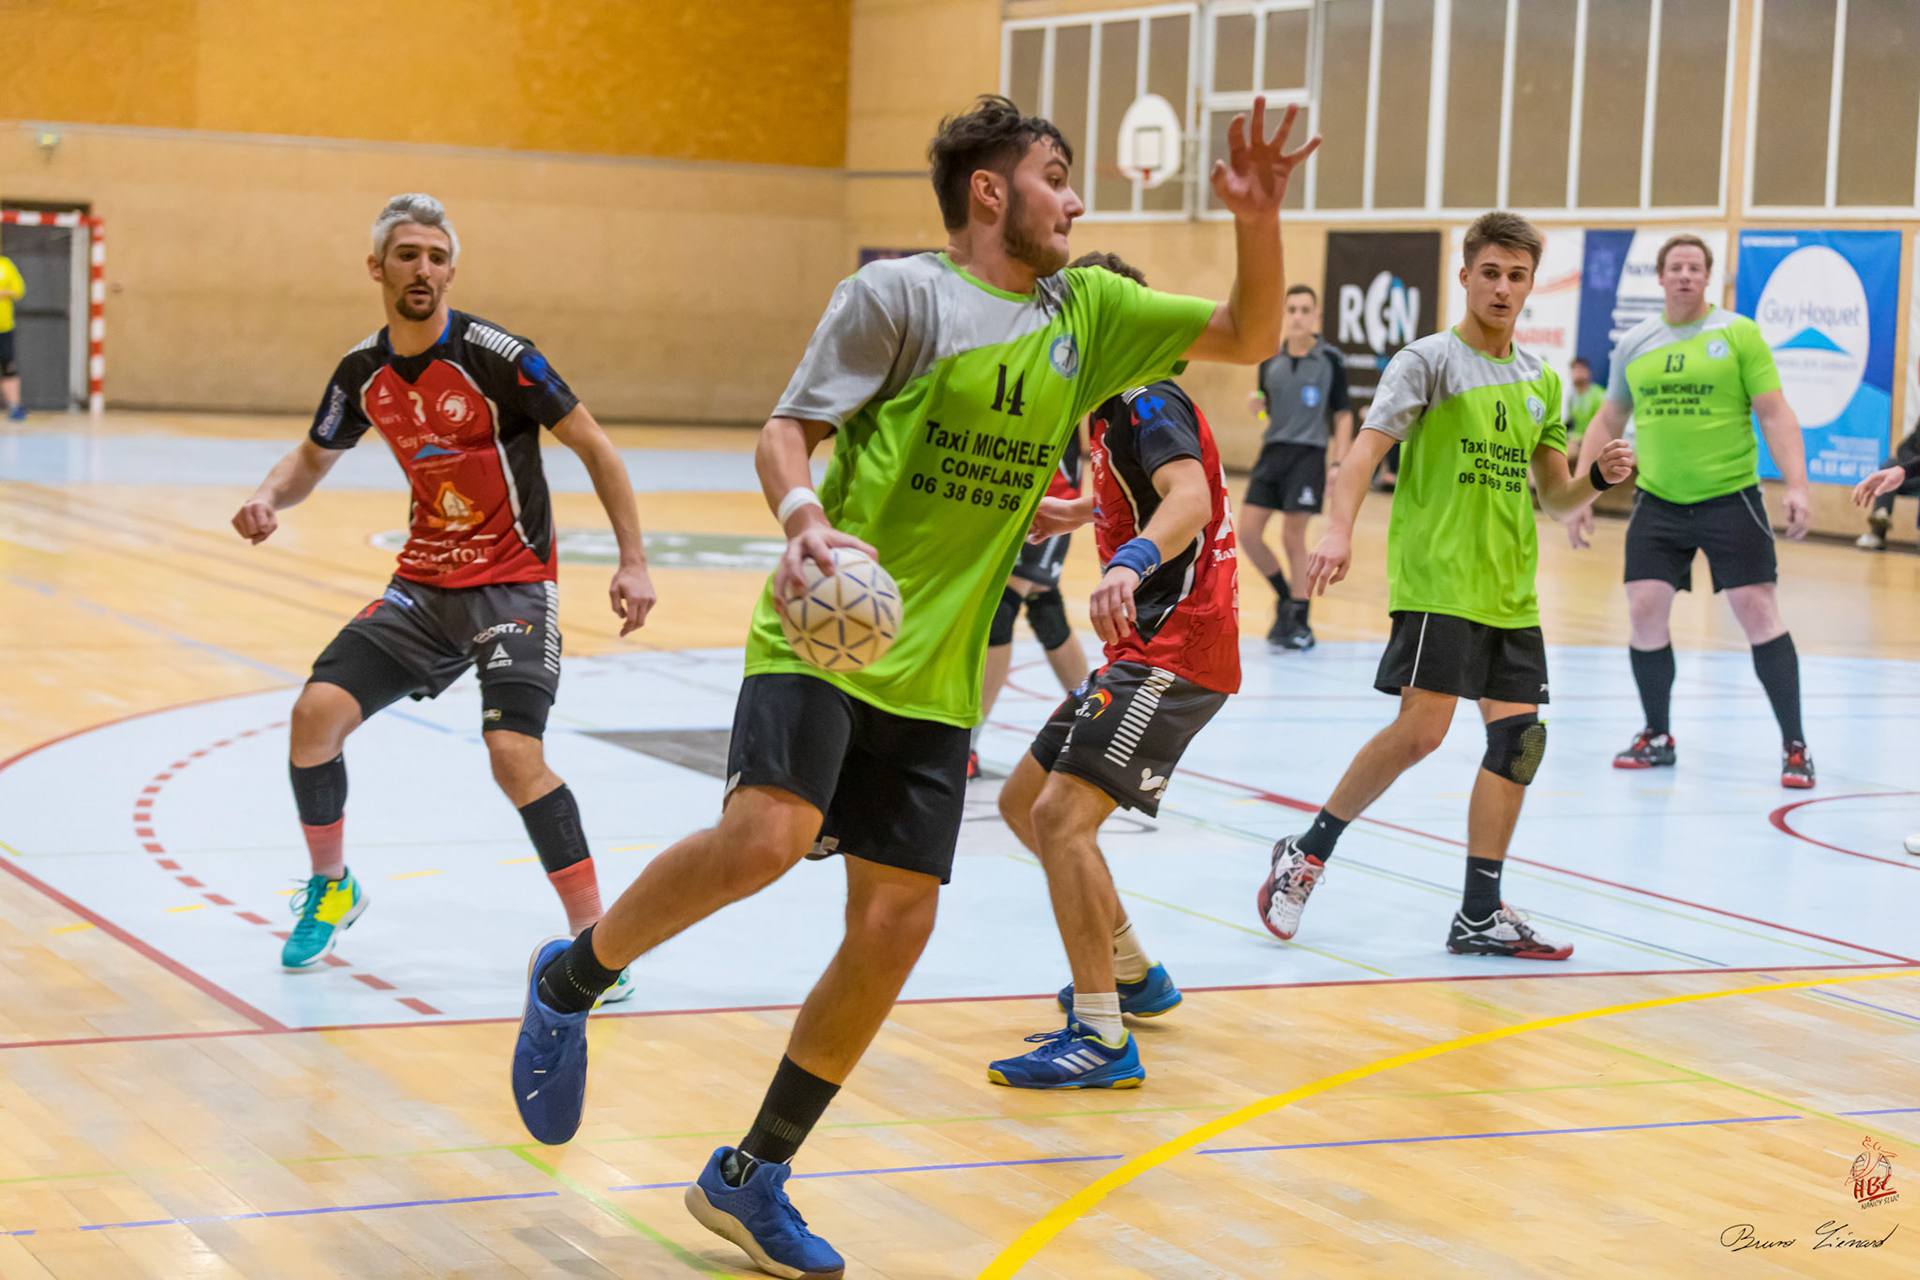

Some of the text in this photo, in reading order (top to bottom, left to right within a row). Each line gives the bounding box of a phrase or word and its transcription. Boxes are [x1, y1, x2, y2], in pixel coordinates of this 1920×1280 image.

[1763, 300, 1860, 329] Guy Hoquet
[1663, 354, 1685, 373] 13
[991, 363, 1026, 417] 14
[1495, 400, 1507, 433] 8
[925, 420, 970, 453] Taxi
[971, 432, 1056, 468] MICHELE
[1461, 439, 1487, 454] Taxi
[941, 456, 1035, 490] CONFLANS
[1459, 472, 1476, 484] 06
[1505, 481, 1522, 493] 56
[1475, 458, 1527, 479] COFLANS
[911, 472, 1021, 513] 06 38 69 56
